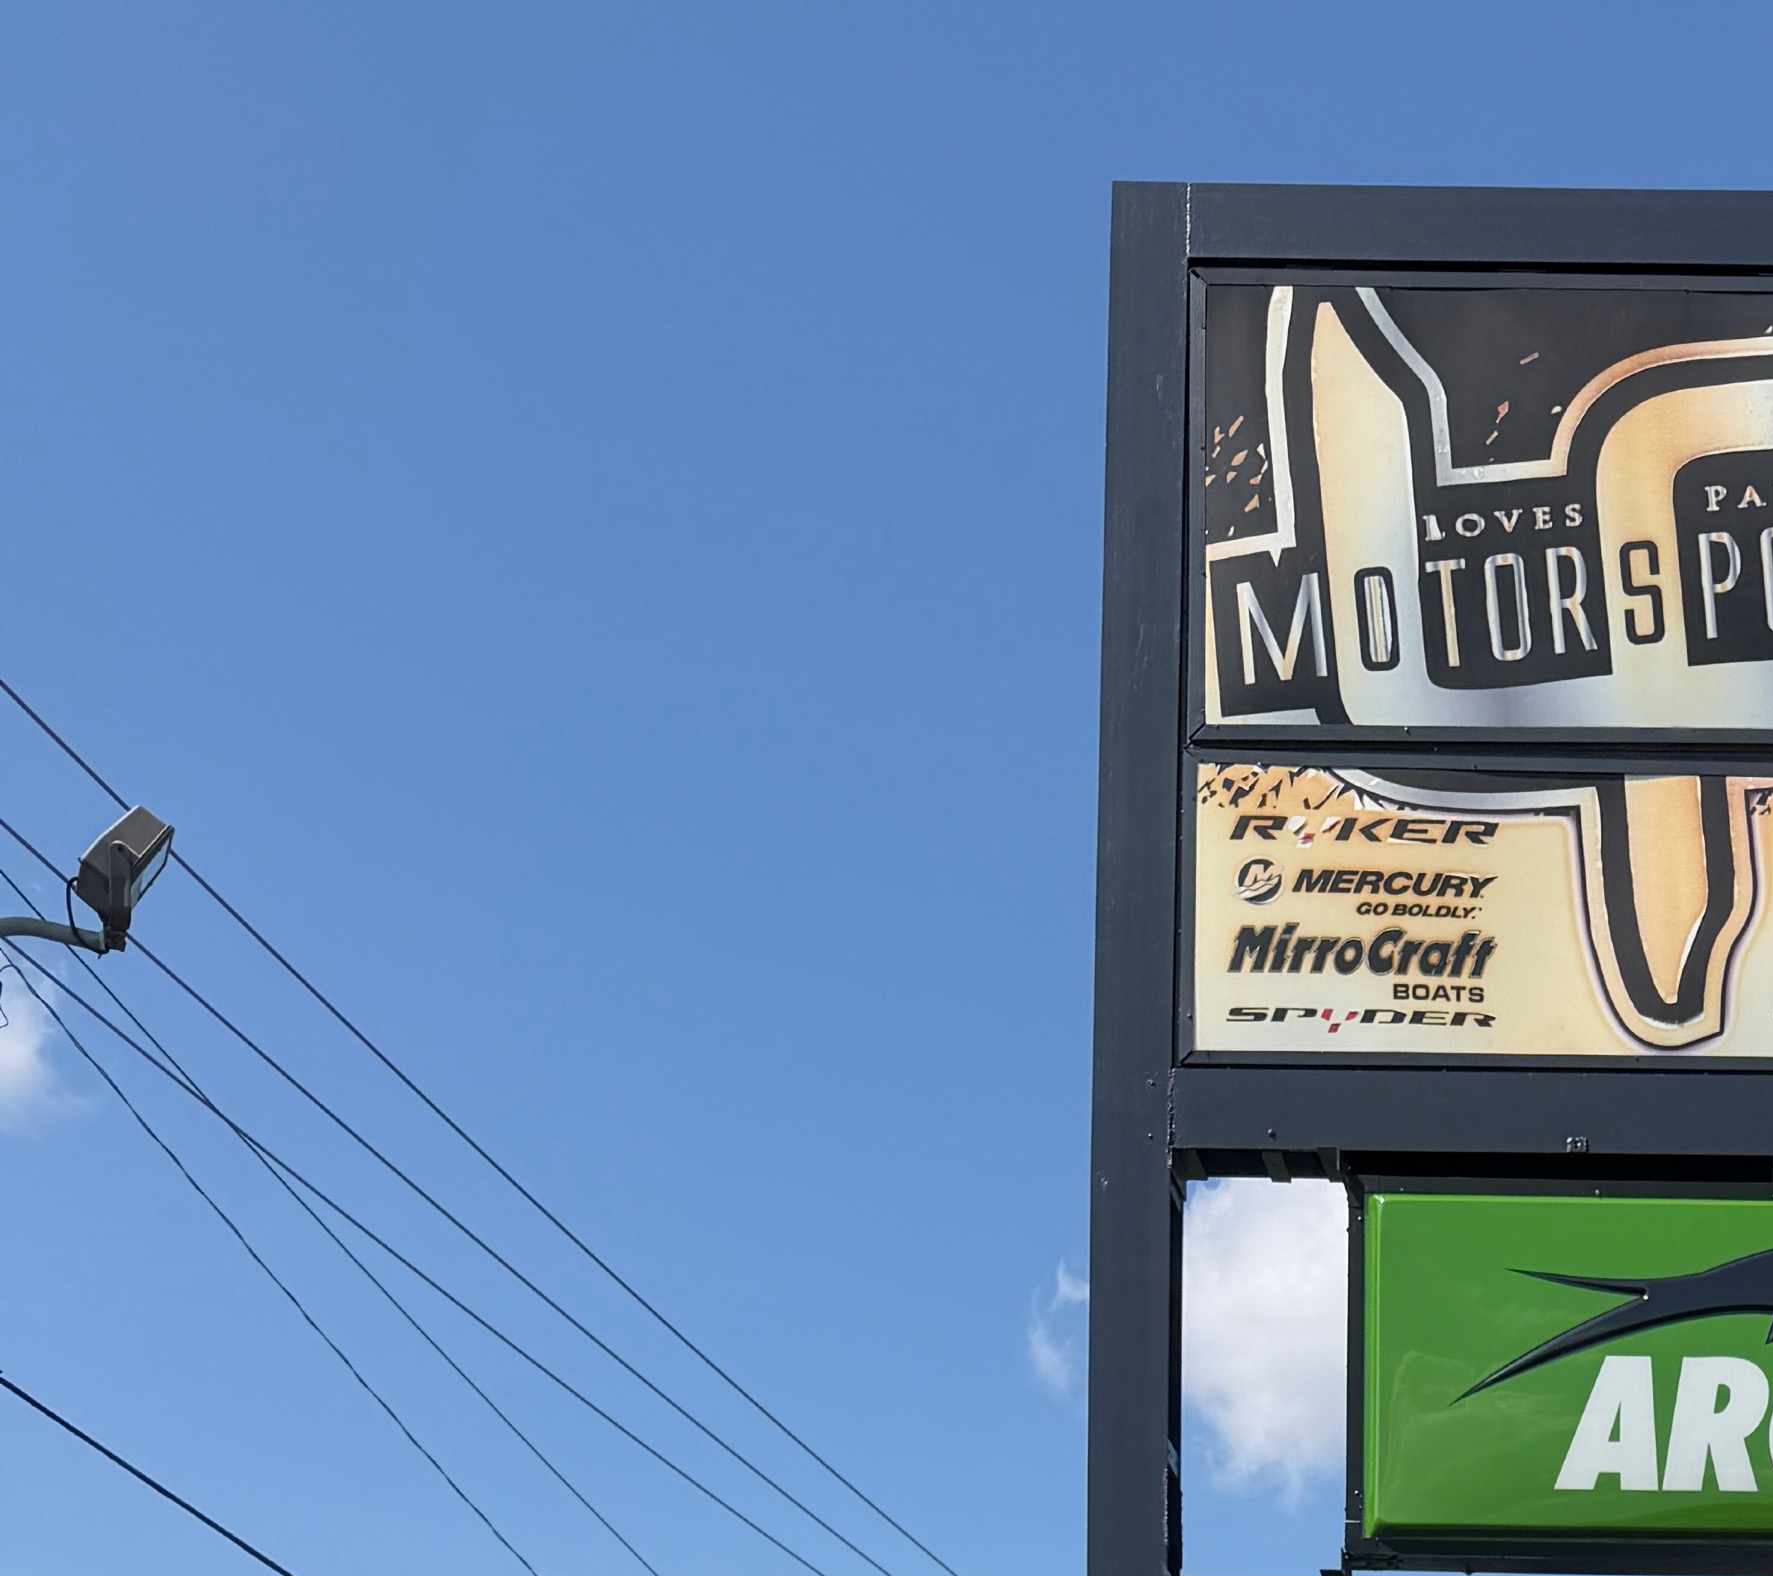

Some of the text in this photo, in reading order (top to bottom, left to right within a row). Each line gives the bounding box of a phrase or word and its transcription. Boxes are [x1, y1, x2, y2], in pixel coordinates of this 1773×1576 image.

[1422, 503, 1583, 541] LOVES
[1292, 868, 1498, 899] MERCURY
[1356, 902, 1388, 917] GO
[1226, 921, 1499, 979] MirroCraft
[1393, 983, 1485, 1003] BOATS
[1226, 1006, 1497, 1033] SPYDER
